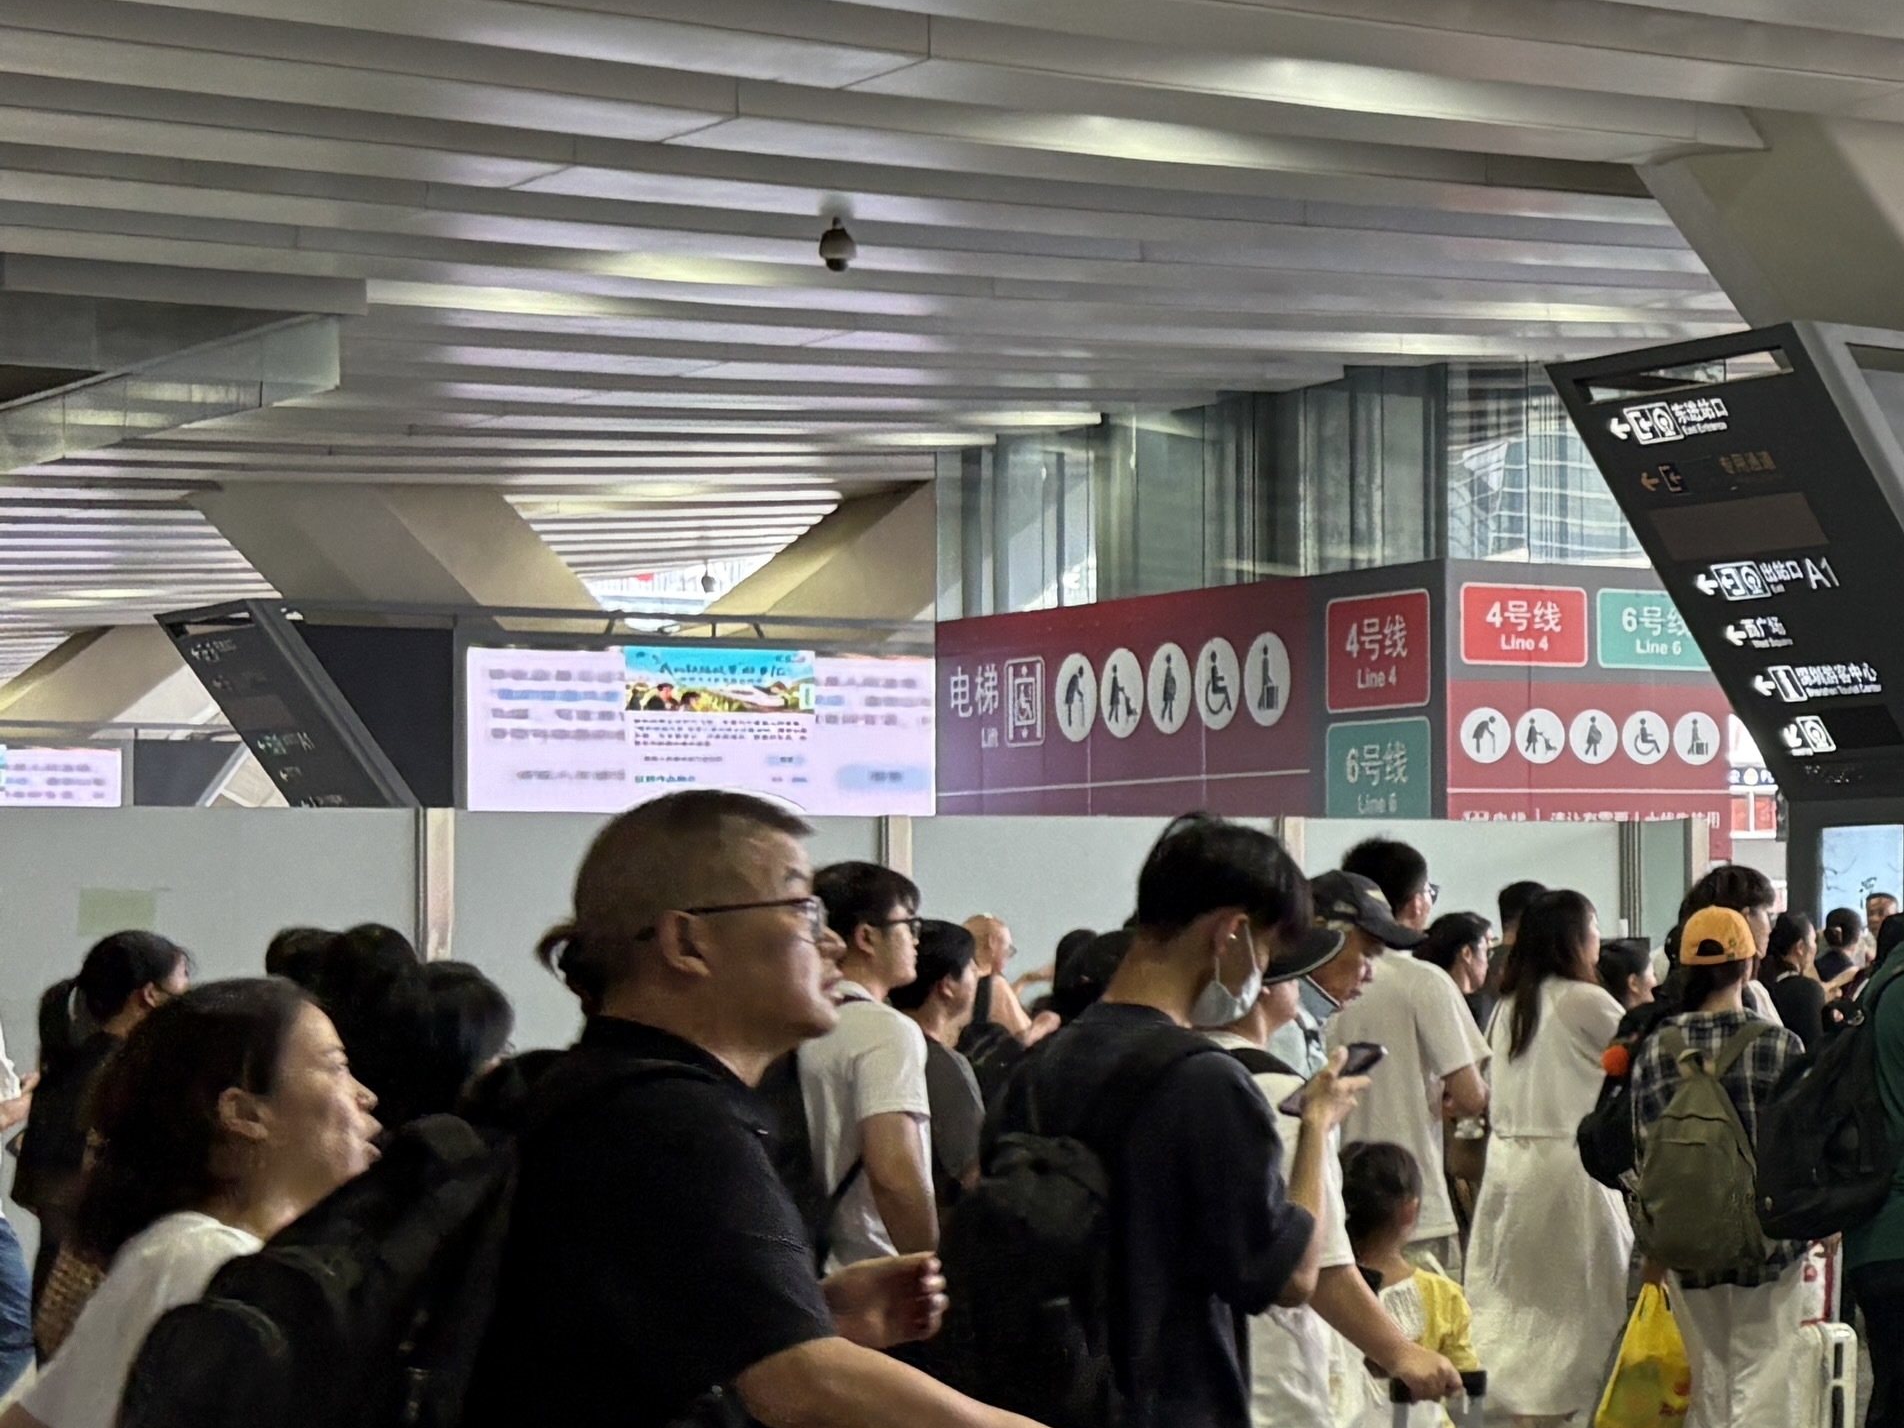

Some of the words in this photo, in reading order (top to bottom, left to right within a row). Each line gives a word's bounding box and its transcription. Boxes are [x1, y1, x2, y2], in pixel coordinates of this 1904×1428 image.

[1671, 398, 1728, 423] 东进站口
[1759, 560, 1804, 583] 出站口
[1804, 556, 1840, 590] A1
[1485, 600, 1562, 633] 4号线
[1741, 617, 1787, 639] 西广场
[1345, 614, 1408, 661] 4号线
[1500, 634, 1535, 651] Line
[1538, 635, 1549, 652] 4
[1635, 638, 1668, 655] Line
[1672, 639, 1682, 656] 6
[1357, 667, 1386, 689] Line
[1388, 665, 1397, 686] 4
[949, 665, 999, 719] 电梯
[981, 727, 999, 748] Lift
[1345, 740, 1408, 786] 6号线
[1358, 793, 1386, 814] Line
